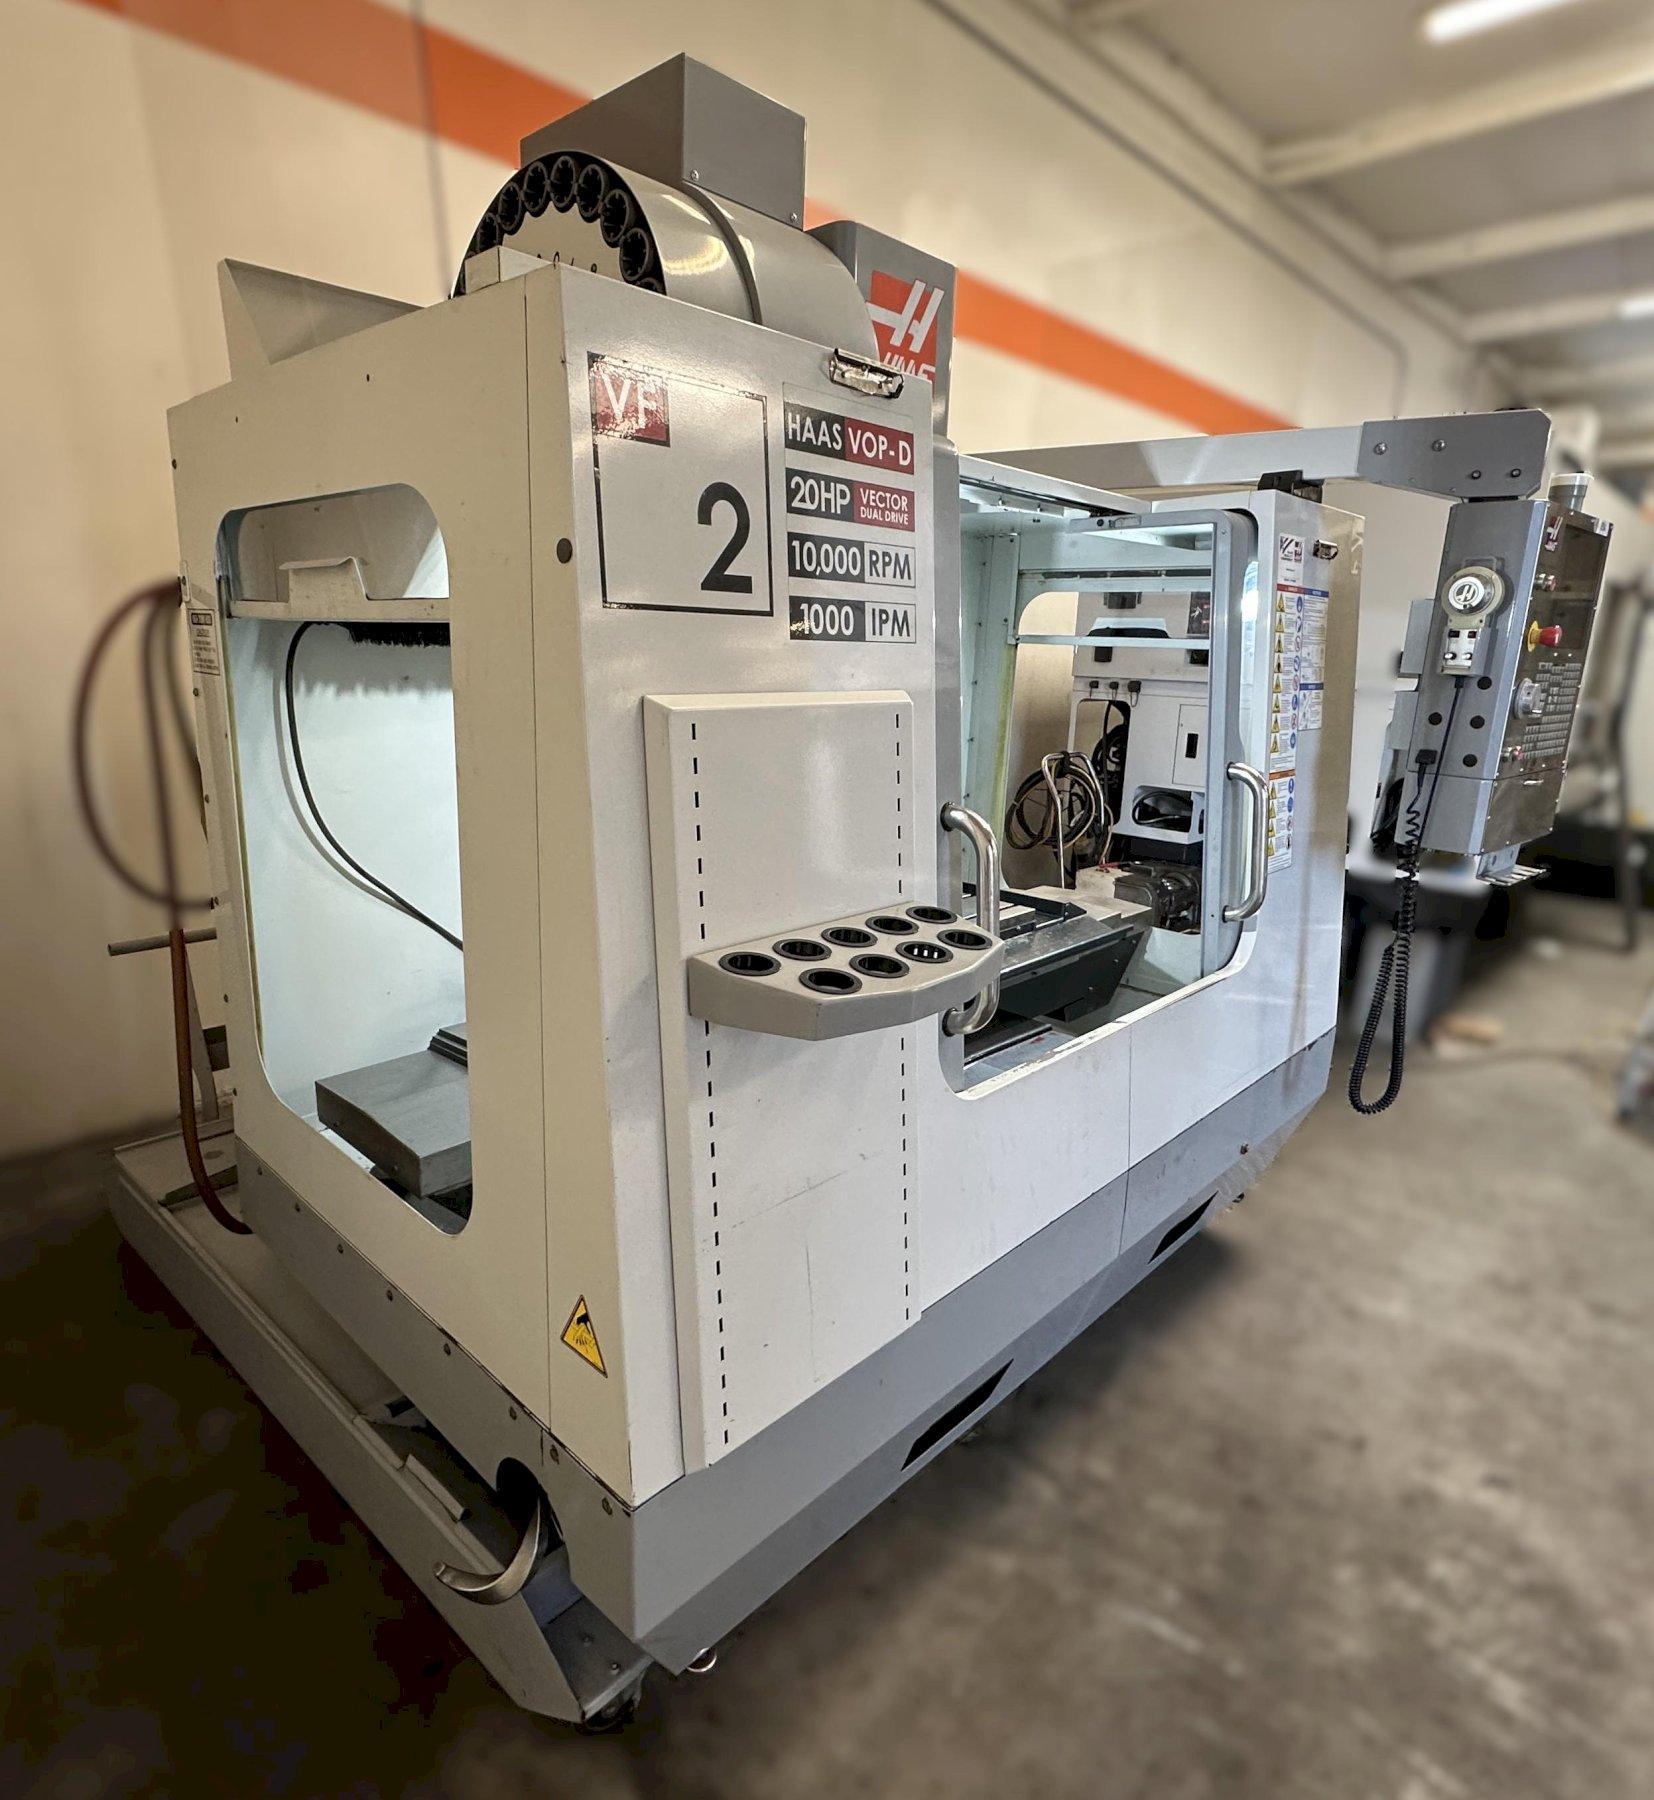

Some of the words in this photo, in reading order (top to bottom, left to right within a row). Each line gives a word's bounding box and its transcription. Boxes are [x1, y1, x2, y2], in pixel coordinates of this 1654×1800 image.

[601, 368, 658, 429] VF
[787, 412, 842, 451] HAAS
[848, 426, 911, 467] VOP-D
[790, 475, 850, 515] 20HP
[860, 487, 908, 512] VECTOR
[860, 506, 883, 521] DUAL
[885, 509, 908, 526] DRIVE
[698, 482, 753, 594] 2
[791, 540, 861, 576] 10,000
[868, 549, 912, 580] RPM
[800, 603, 854, 636] 1000
[871, 607, 910, 637] IPM
